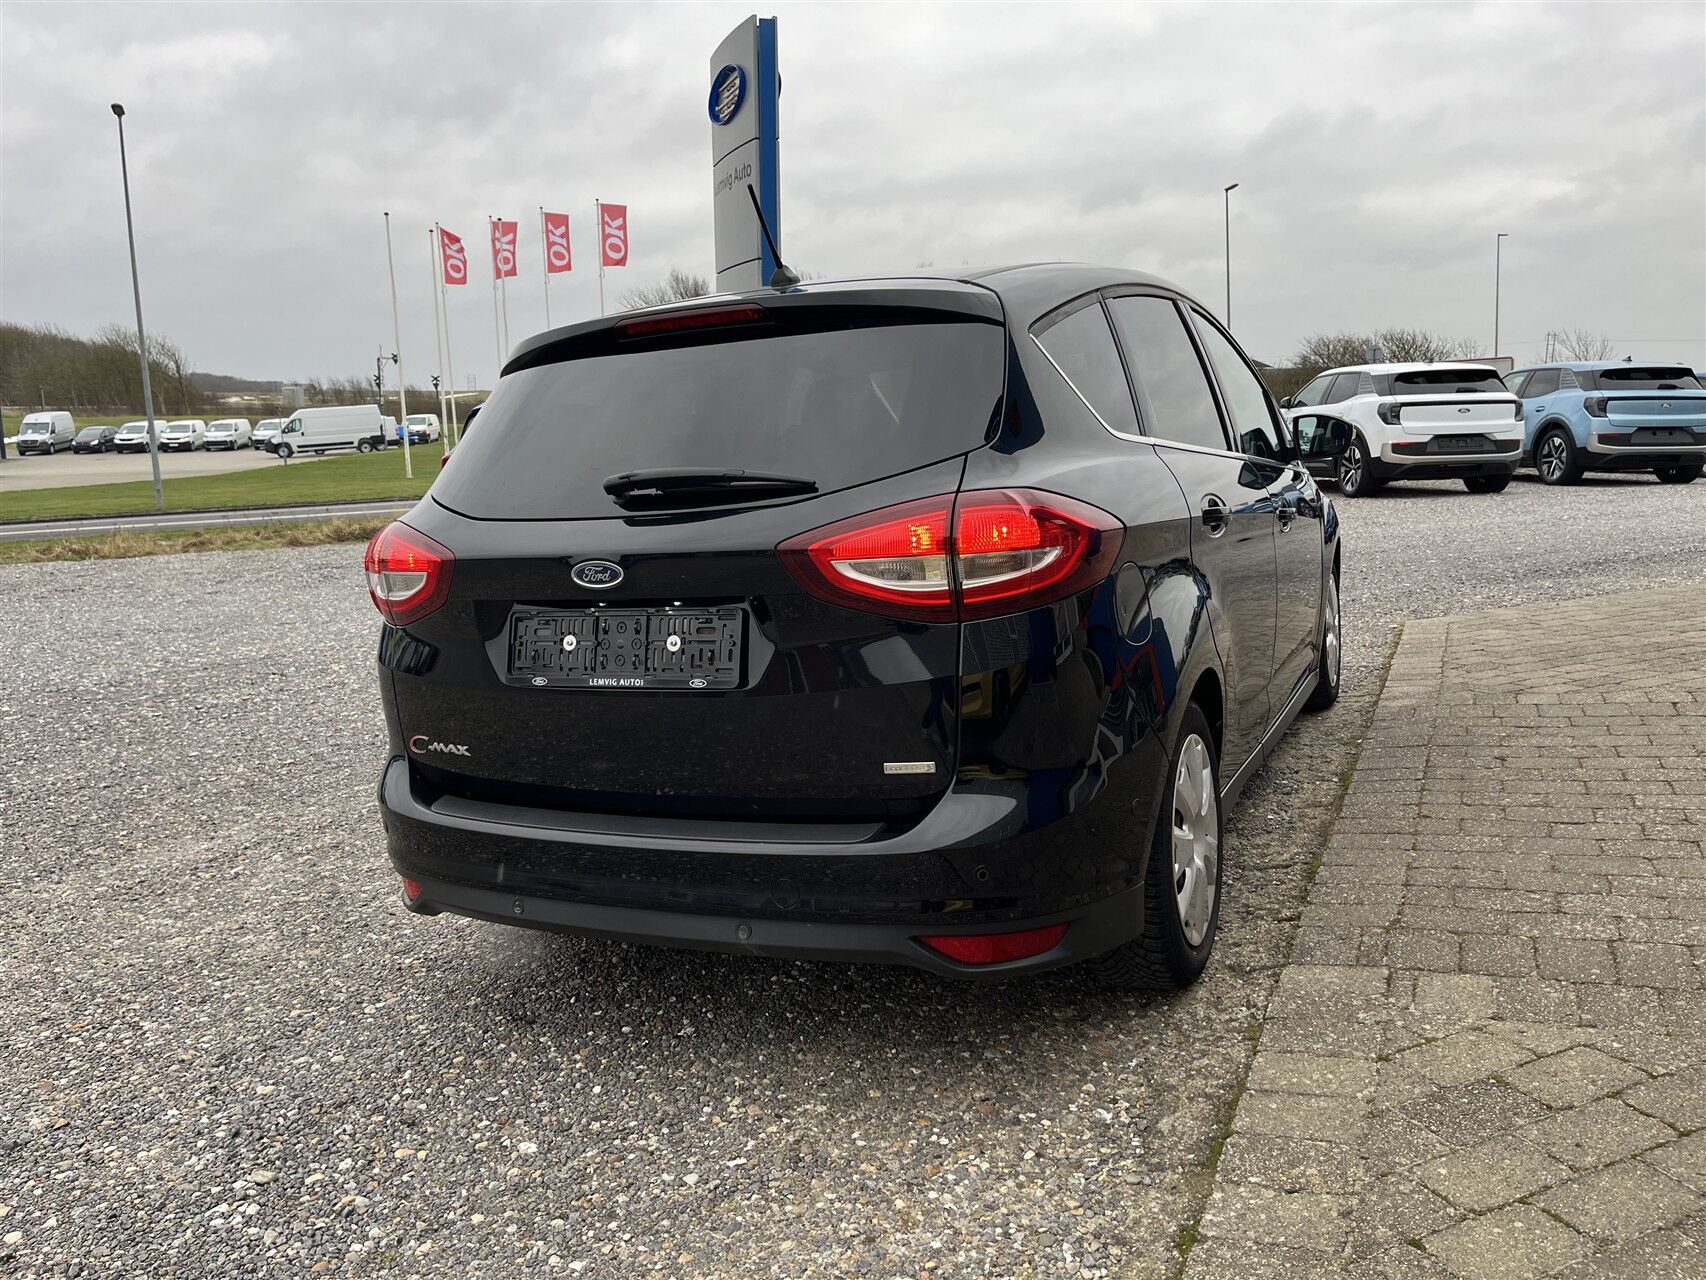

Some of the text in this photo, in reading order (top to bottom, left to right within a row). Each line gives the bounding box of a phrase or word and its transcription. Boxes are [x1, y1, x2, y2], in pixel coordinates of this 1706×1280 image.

[734, 163, 752, 184] Auto
[496, 230, 514, 272] OK
[547, 222, 569, 267] OK
[604, 213, 625, 260] OK
[445, 235, 464, 279] OK
[583, 566, 610, 581] Ford
[589, 678, 617, 686] LEMVIG
[409, 735, 472, 757] C-MAX
